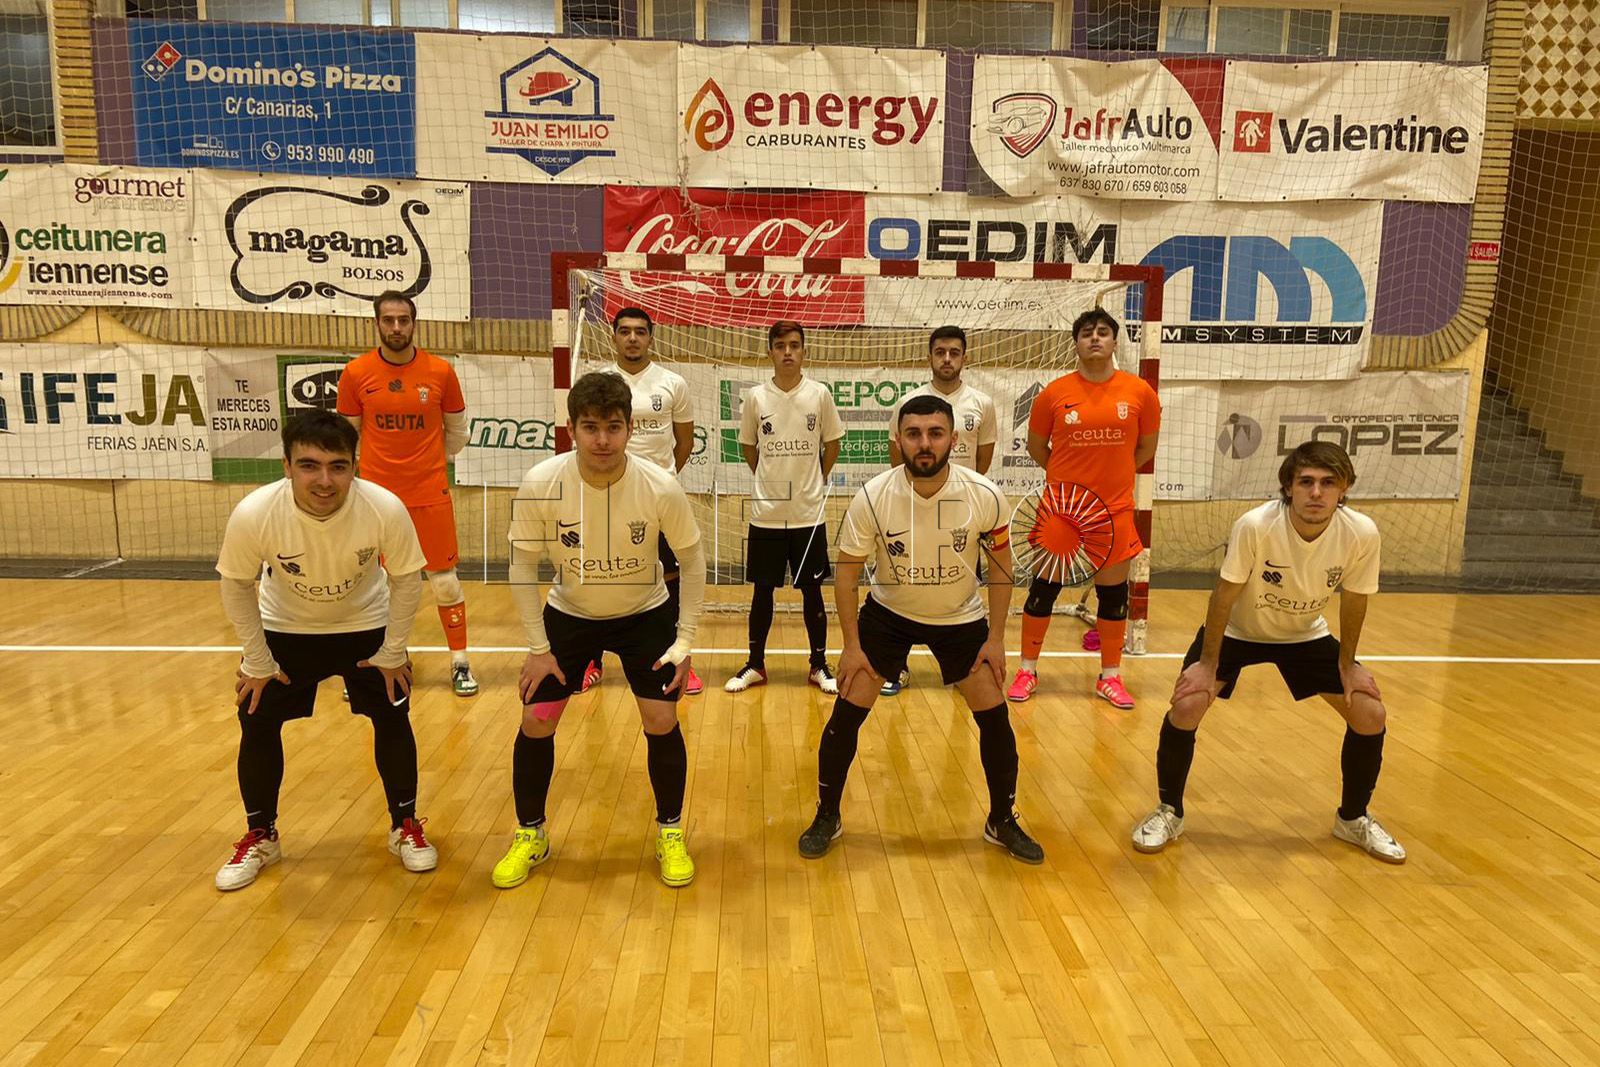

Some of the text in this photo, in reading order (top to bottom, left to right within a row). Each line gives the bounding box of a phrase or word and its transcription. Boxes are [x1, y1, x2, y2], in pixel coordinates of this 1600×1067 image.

[185, 59, 402, 93] Domino's Pizza
[225, 97, 332, 122] C/ Canarias, 1
[744, 91, 939, 146] energy
[1063, 107, 1192, 140] JafrAuto
[491, 121, 609, 139] JUAN EMILIO
[1278, 114, 1469, 154] Valentine
[746, 134, 866, 150] CARBURANTES
[1061, 141, 1087, 152] Taller
[1141, 141, 1191, 154] Multimarca
[287, 146, 374, 165] 953 990 490
[1048, 160, 1200, 178] www.jafrautomotor.com
[75, 177, 186, 203] gourmet
[1059, 177, 1079, 188] 637
[1081, 178, 1102, 191] 830
[1104, 180, 1124, 192] 670
[1132, 180, 1151, 192] 659
[1153, 181, 1169, 193] 603
[1170, 182, 1187, 194] 058
[248, 228, 407, 263] magama
[868, 217, 1118, 264] OEDIM
[342, 267, 404, 281] BOLSOS
[27, 288, 173, 299] www.aceitunerajiennense.com
[936, 298, 1043, 311] www.oedim.es
[235, 379, 249, 393] TE
[20, 372, 207, 426] IFEJA
[217, 398, 271, 413] MERECES
[212, 418, 278, 432] ESTA RADIO
[375, 414, 425, 430] CEUTA
[1331, 415, 1404, 424] ORTOPEDIA
[1072, 427, 1122, 441] ceuta
[1277, 424, 1459, 457] LOPEZ
[87, 434, 209, 452] FERIAS JAÉN S.A.
[766, 439, 810, 451] ceuta
[569, 556, 640, 572] ceuta
[894, 564, 960, 579] ceuta
